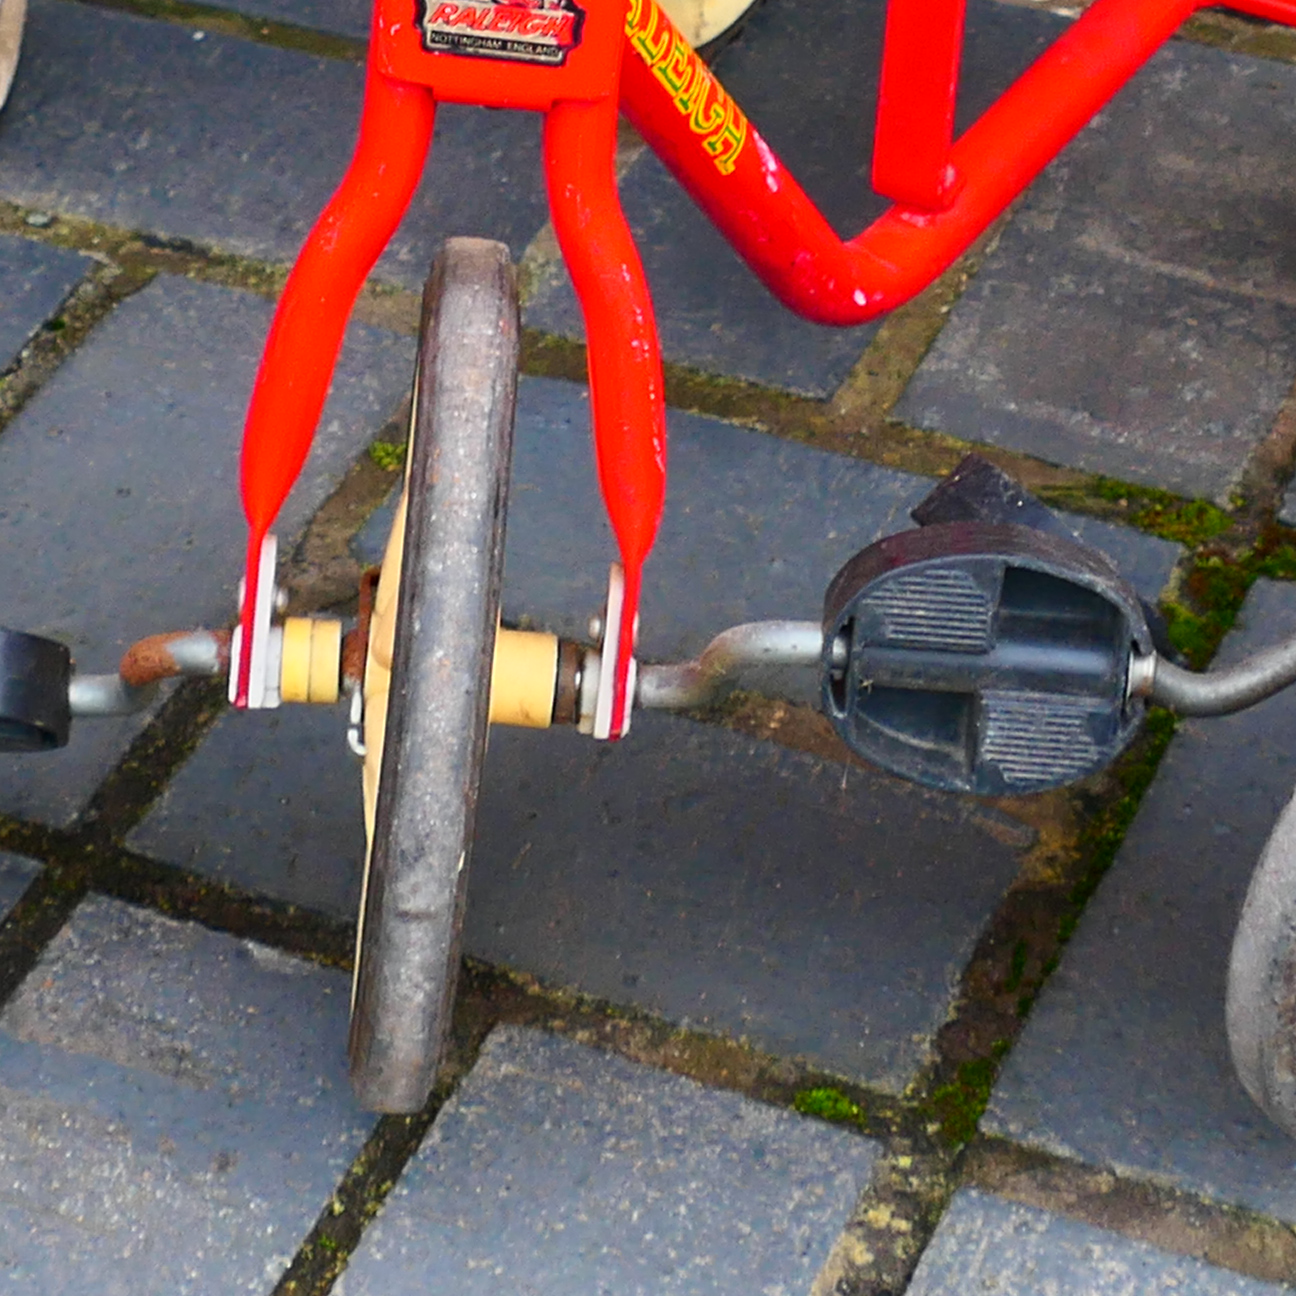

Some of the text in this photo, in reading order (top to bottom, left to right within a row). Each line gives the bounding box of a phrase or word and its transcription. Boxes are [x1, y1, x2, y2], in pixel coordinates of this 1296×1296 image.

[428, 2, 567, 39] RALEIGH
[431, 33, 560, 57] NOTTINGHAM ENGLAND
